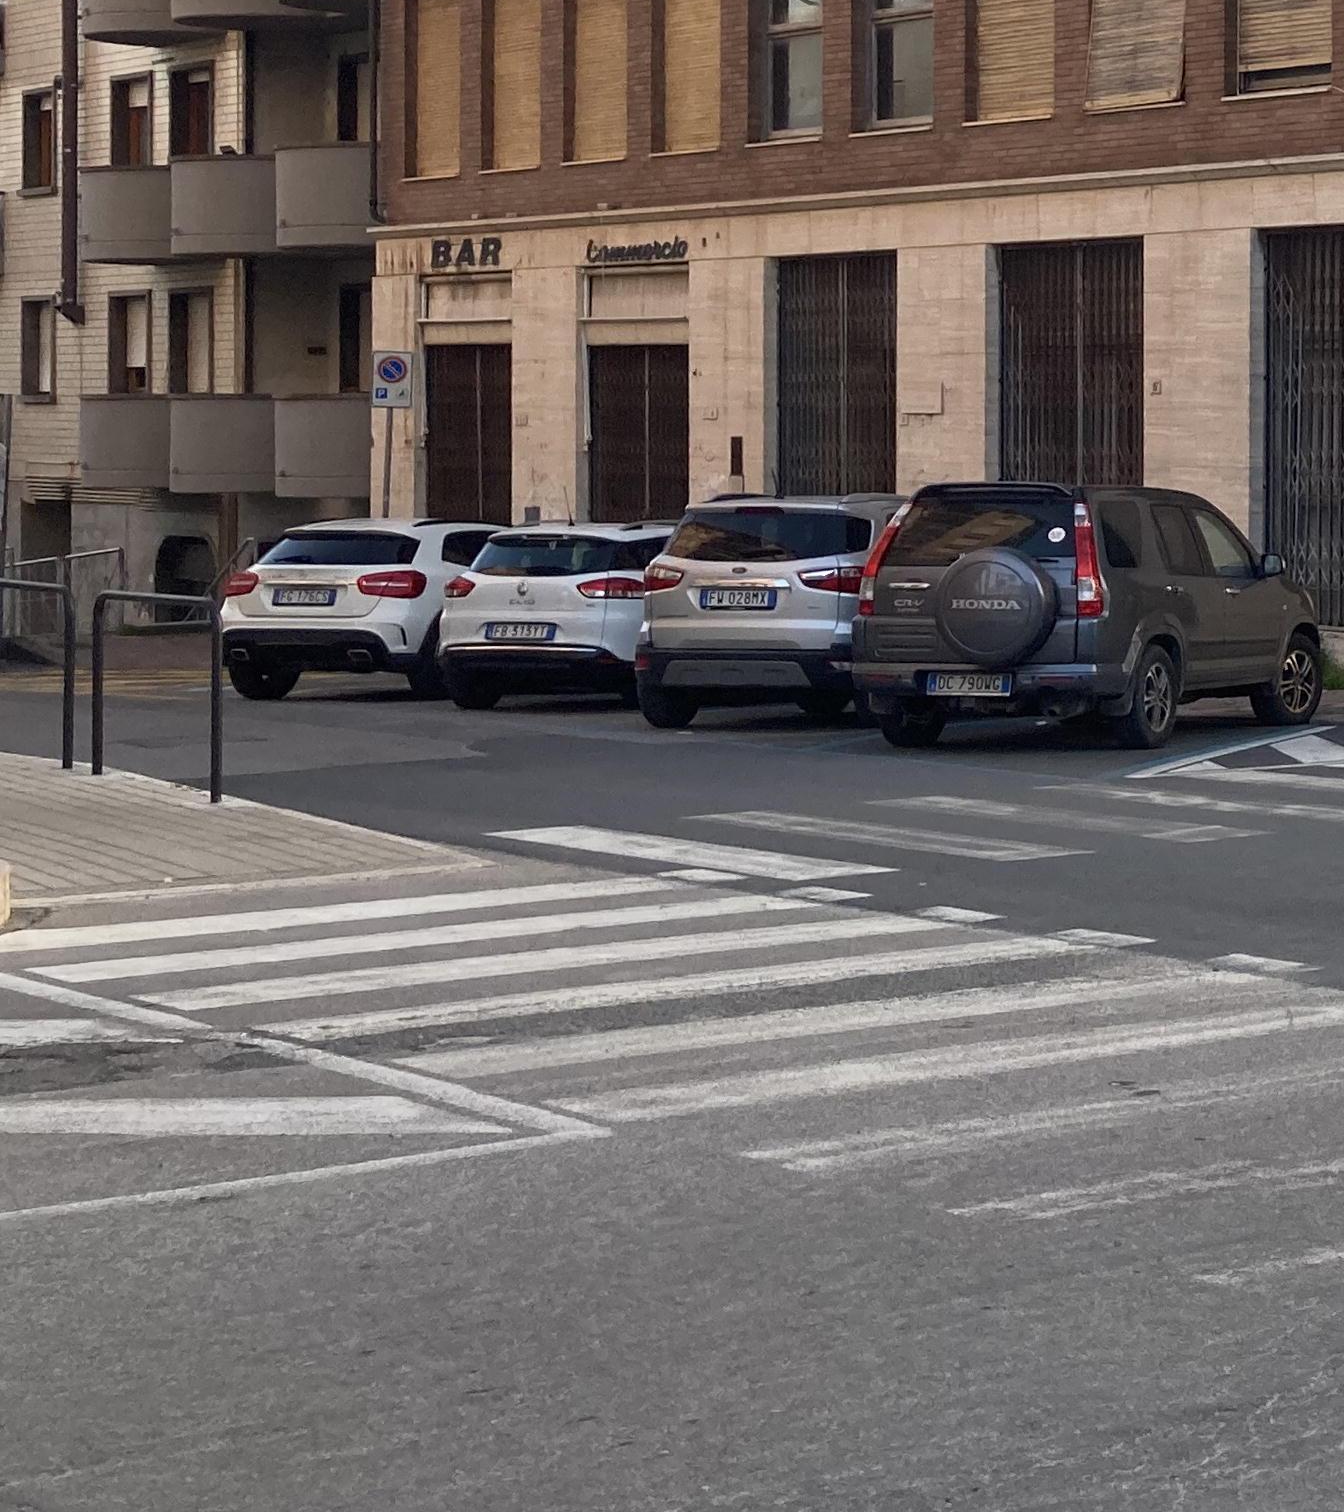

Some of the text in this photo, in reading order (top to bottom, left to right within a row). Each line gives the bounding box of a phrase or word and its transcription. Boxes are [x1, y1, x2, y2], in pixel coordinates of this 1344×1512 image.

[431, 237, 503, 269] BAR
[586, 234, 689, 263] Commercio
[709, 591, 768, 605] FW 028MX
[894, 598, 925, 607] CR-V
[951, 599, 1022, 610] HONDA
[494, 625, 508, 637] FB
[938, 675, 1001, 691] DC 790WG
